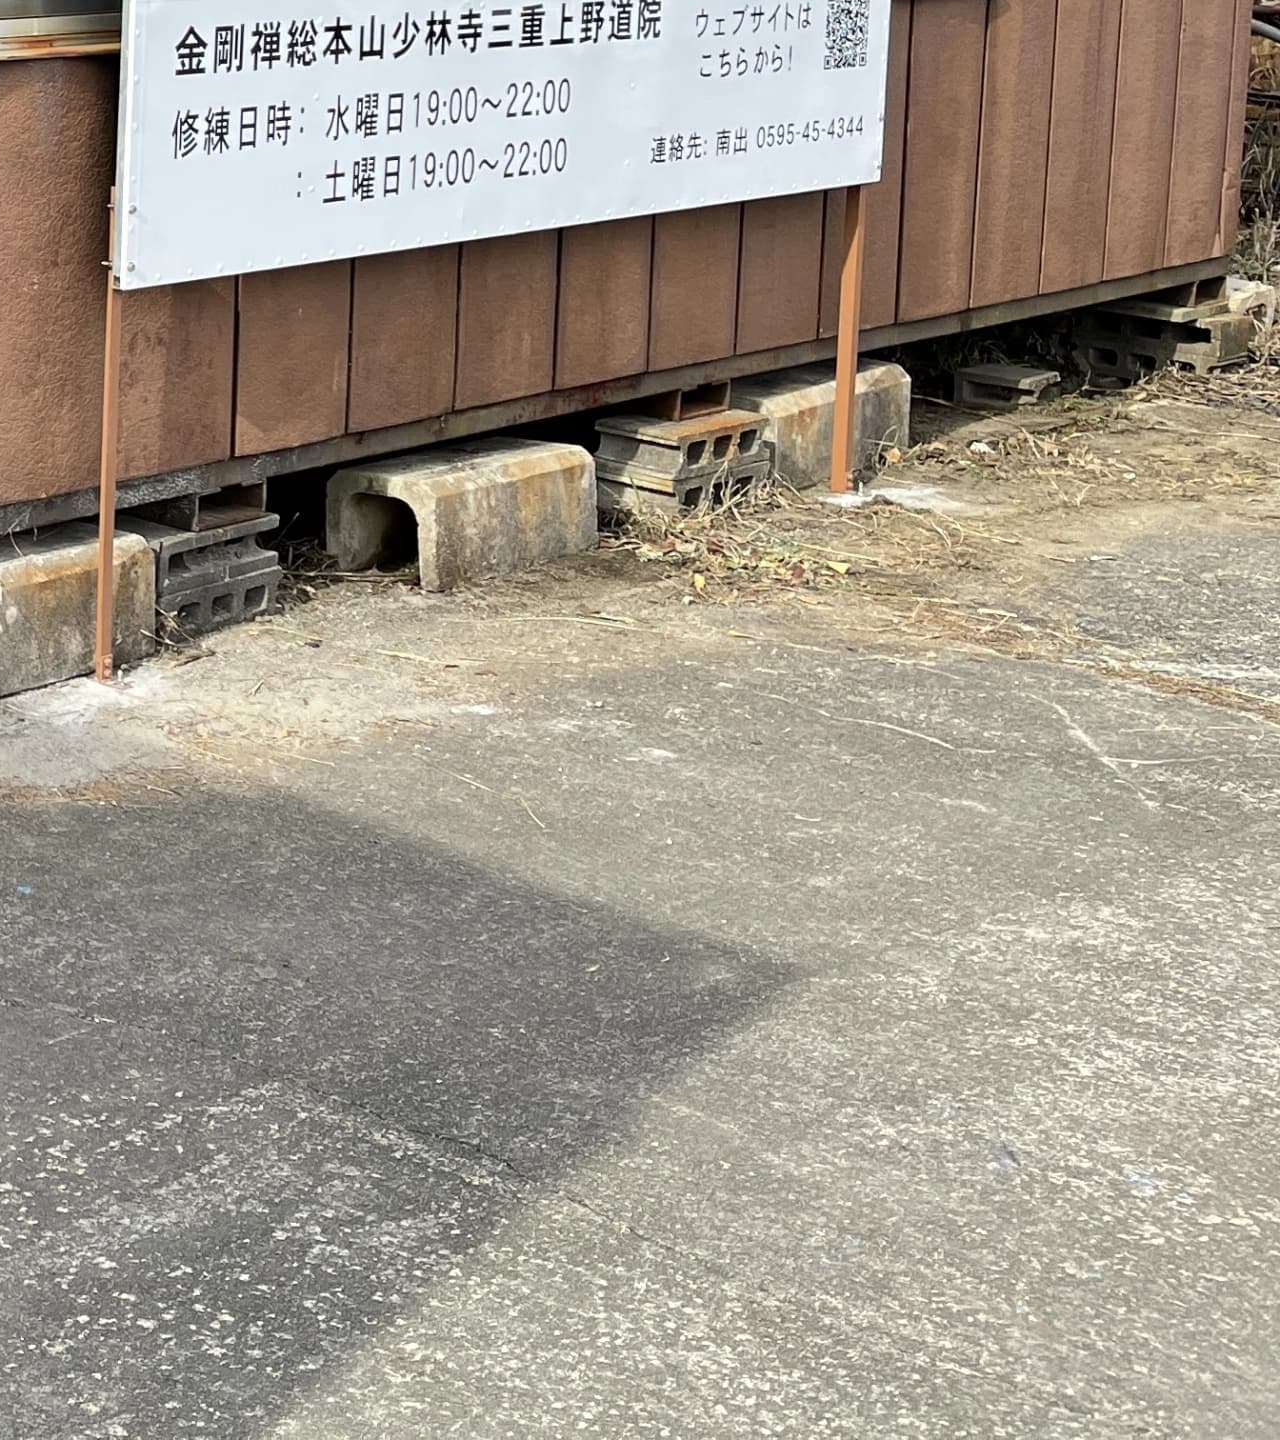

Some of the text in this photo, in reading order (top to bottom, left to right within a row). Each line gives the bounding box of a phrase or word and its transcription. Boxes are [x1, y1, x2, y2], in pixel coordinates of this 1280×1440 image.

[695, 2, 812, 38] ウェブサイトは
[716, 127, 748, 156] 南出
[756, 115, 864, 149] 0595-45-4344
